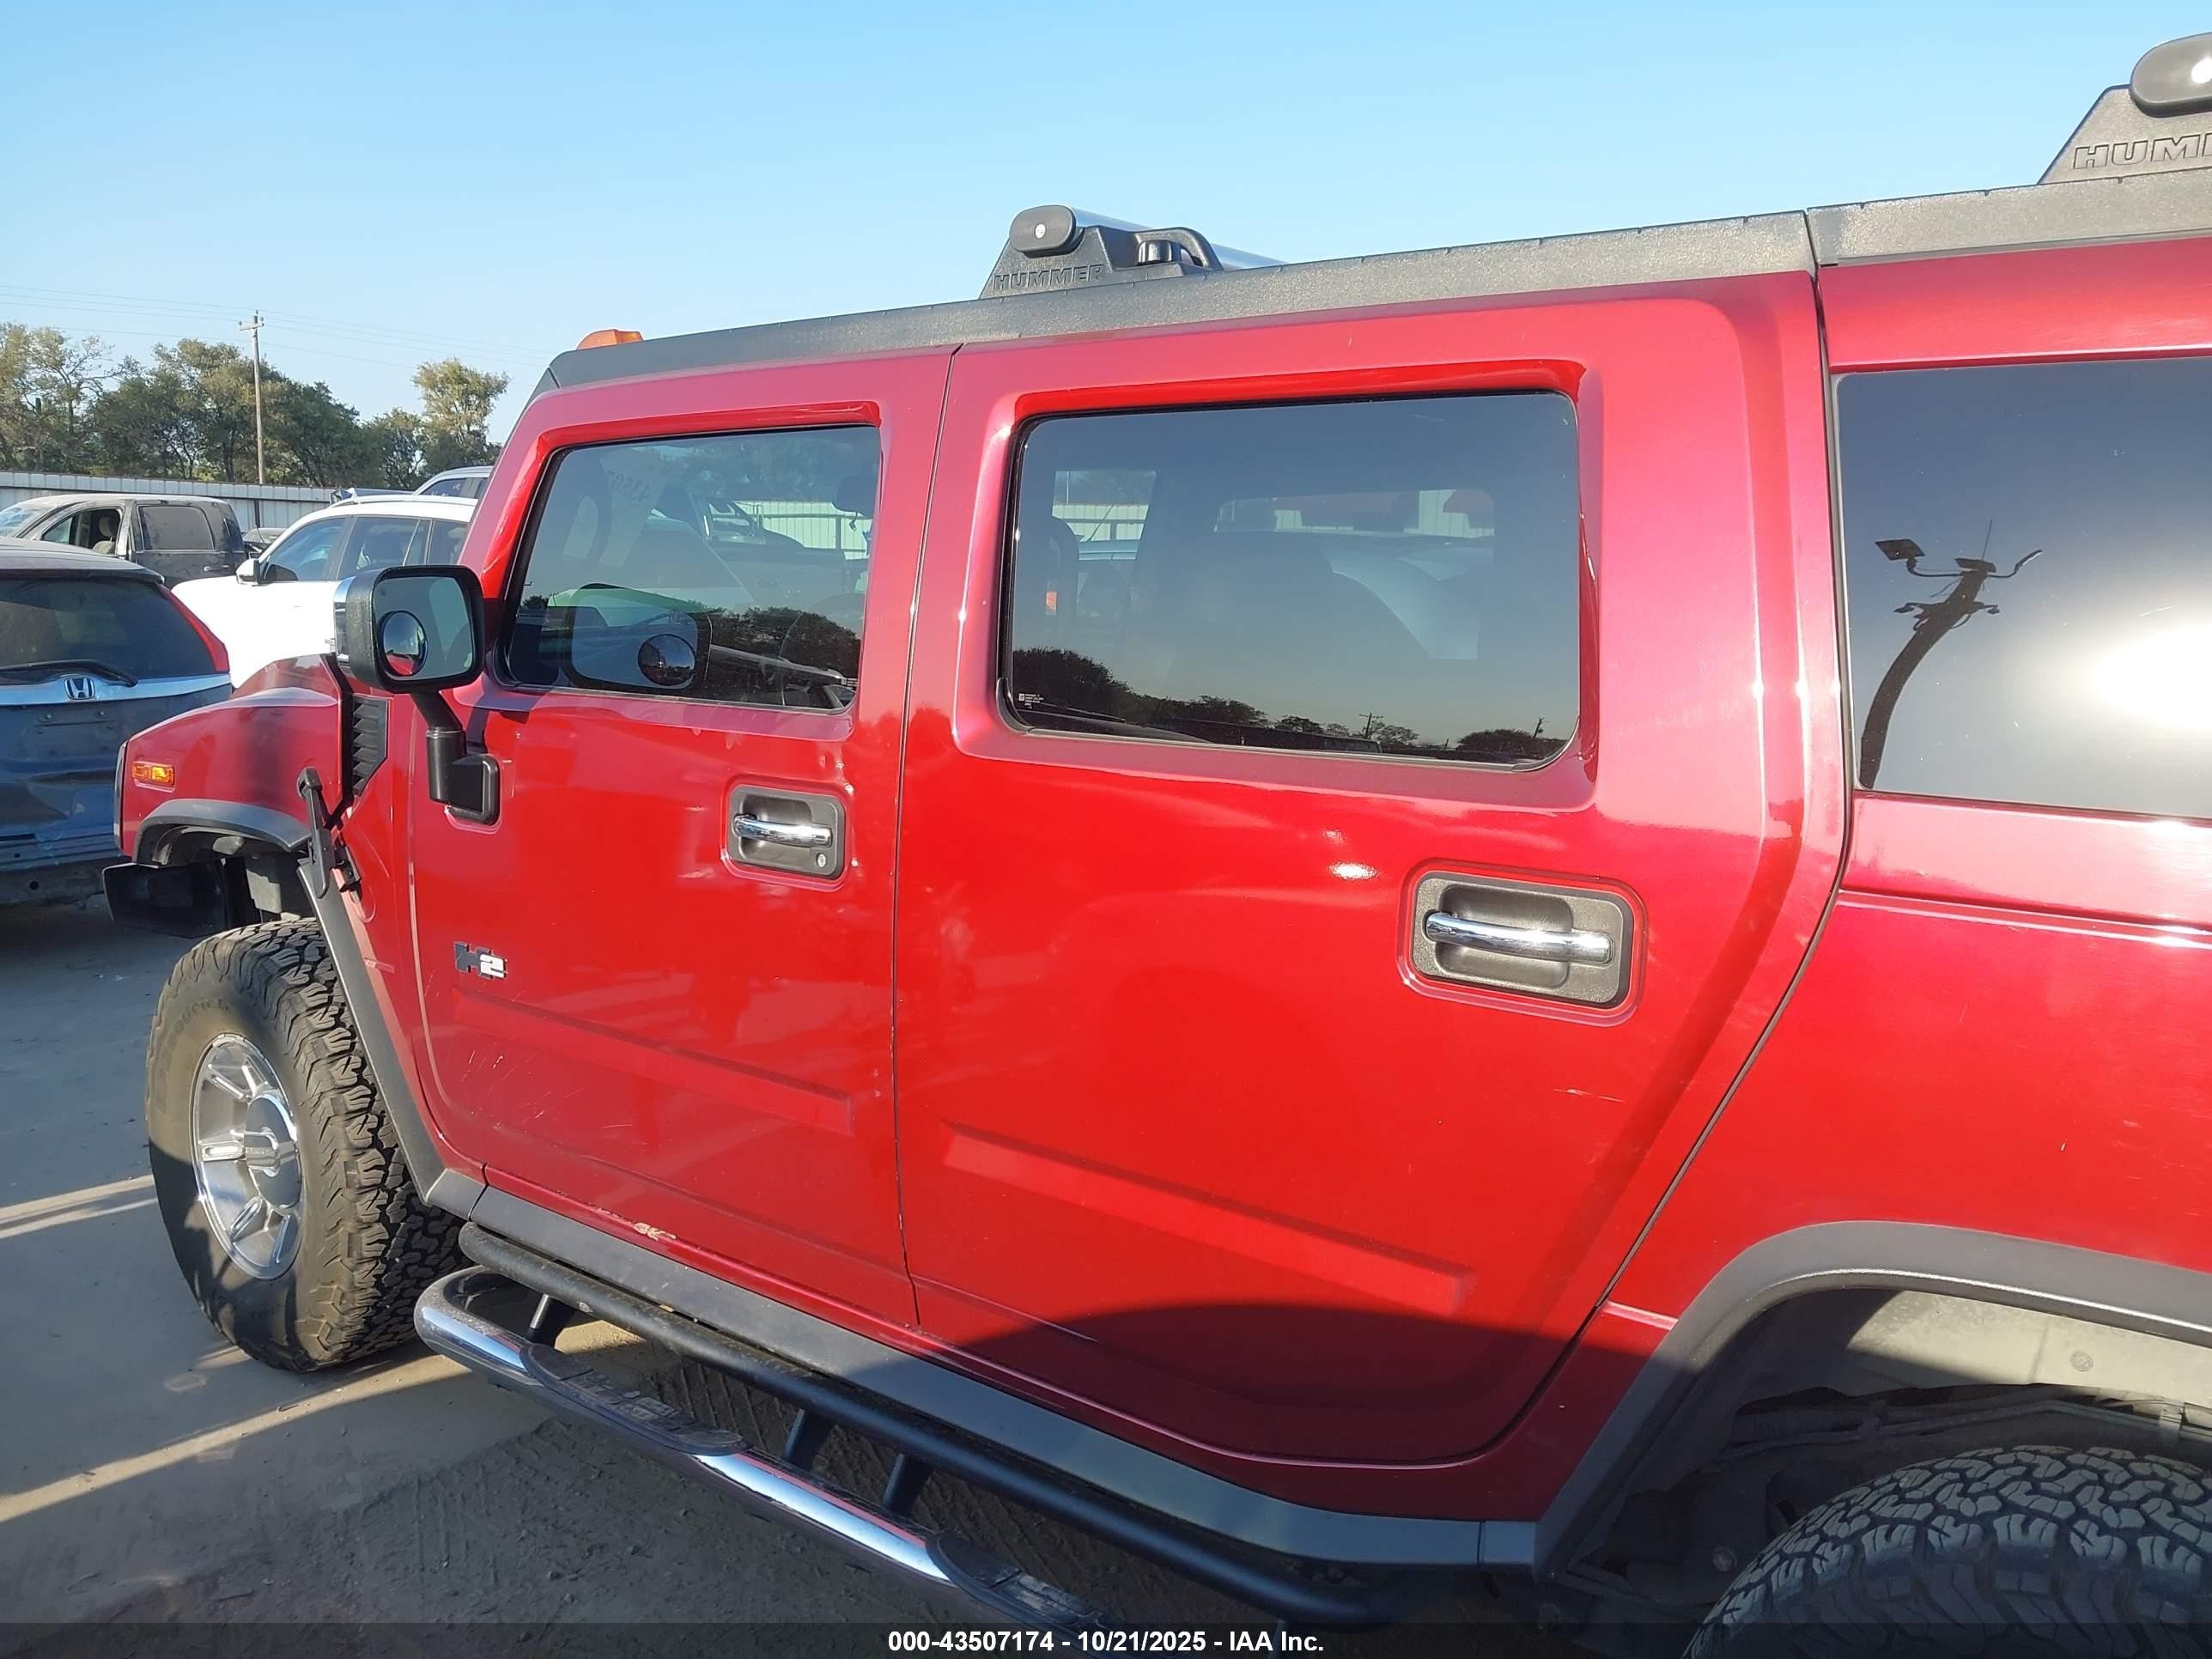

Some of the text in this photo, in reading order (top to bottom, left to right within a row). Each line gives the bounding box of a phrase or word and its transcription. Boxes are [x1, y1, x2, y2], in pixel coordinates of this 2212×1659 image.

[2072, 132, 2212, 170] HUM
[992, 264, 1105, 291] HUMMER
[453, 941, 508, 980] H2
